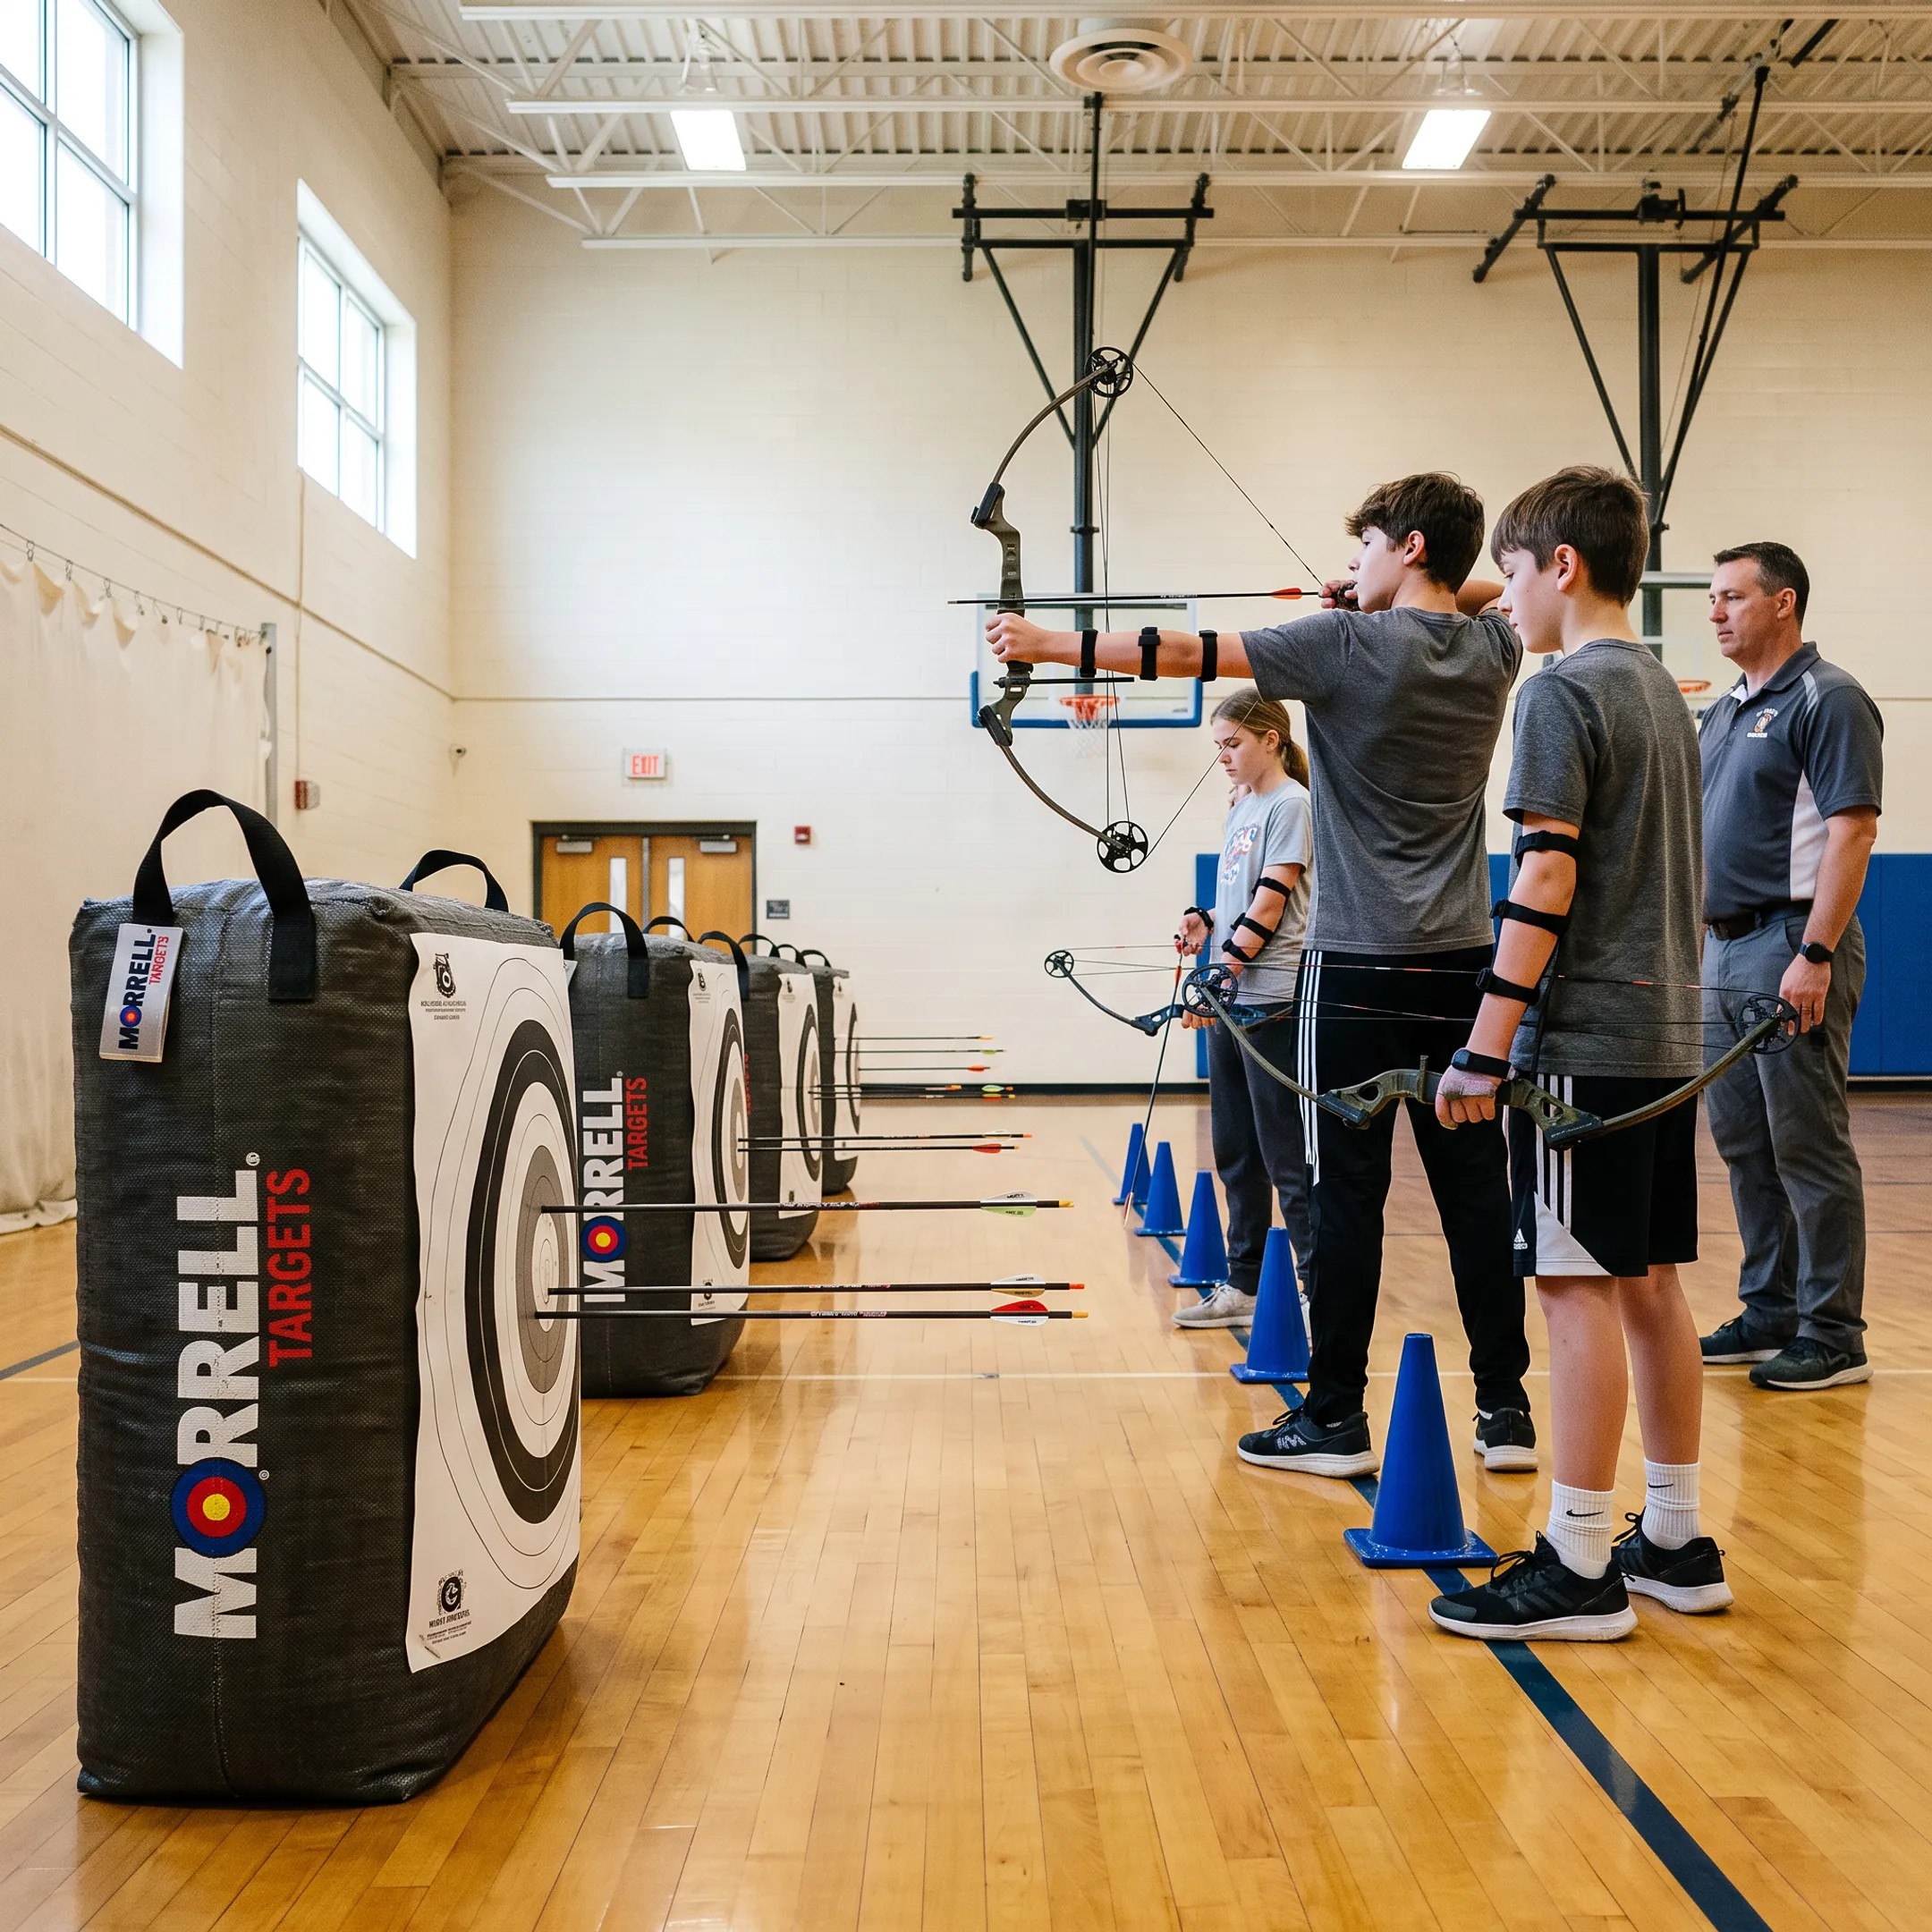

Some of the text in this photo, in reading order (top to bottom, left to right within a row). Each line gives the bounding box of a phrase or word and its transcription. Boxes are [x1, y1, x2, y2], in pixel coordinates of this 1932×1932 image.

[631, 755, 659, 775] EXIT
[118, 934, 157, 1050] MORRELL
[148, 936, 169, 985] TARGETS
[626, 1077, 648, 1171] TARGETS
[267, 1167, 312, 1368] TARGETS
[171, 1169, 266, 1640] MORRELL
